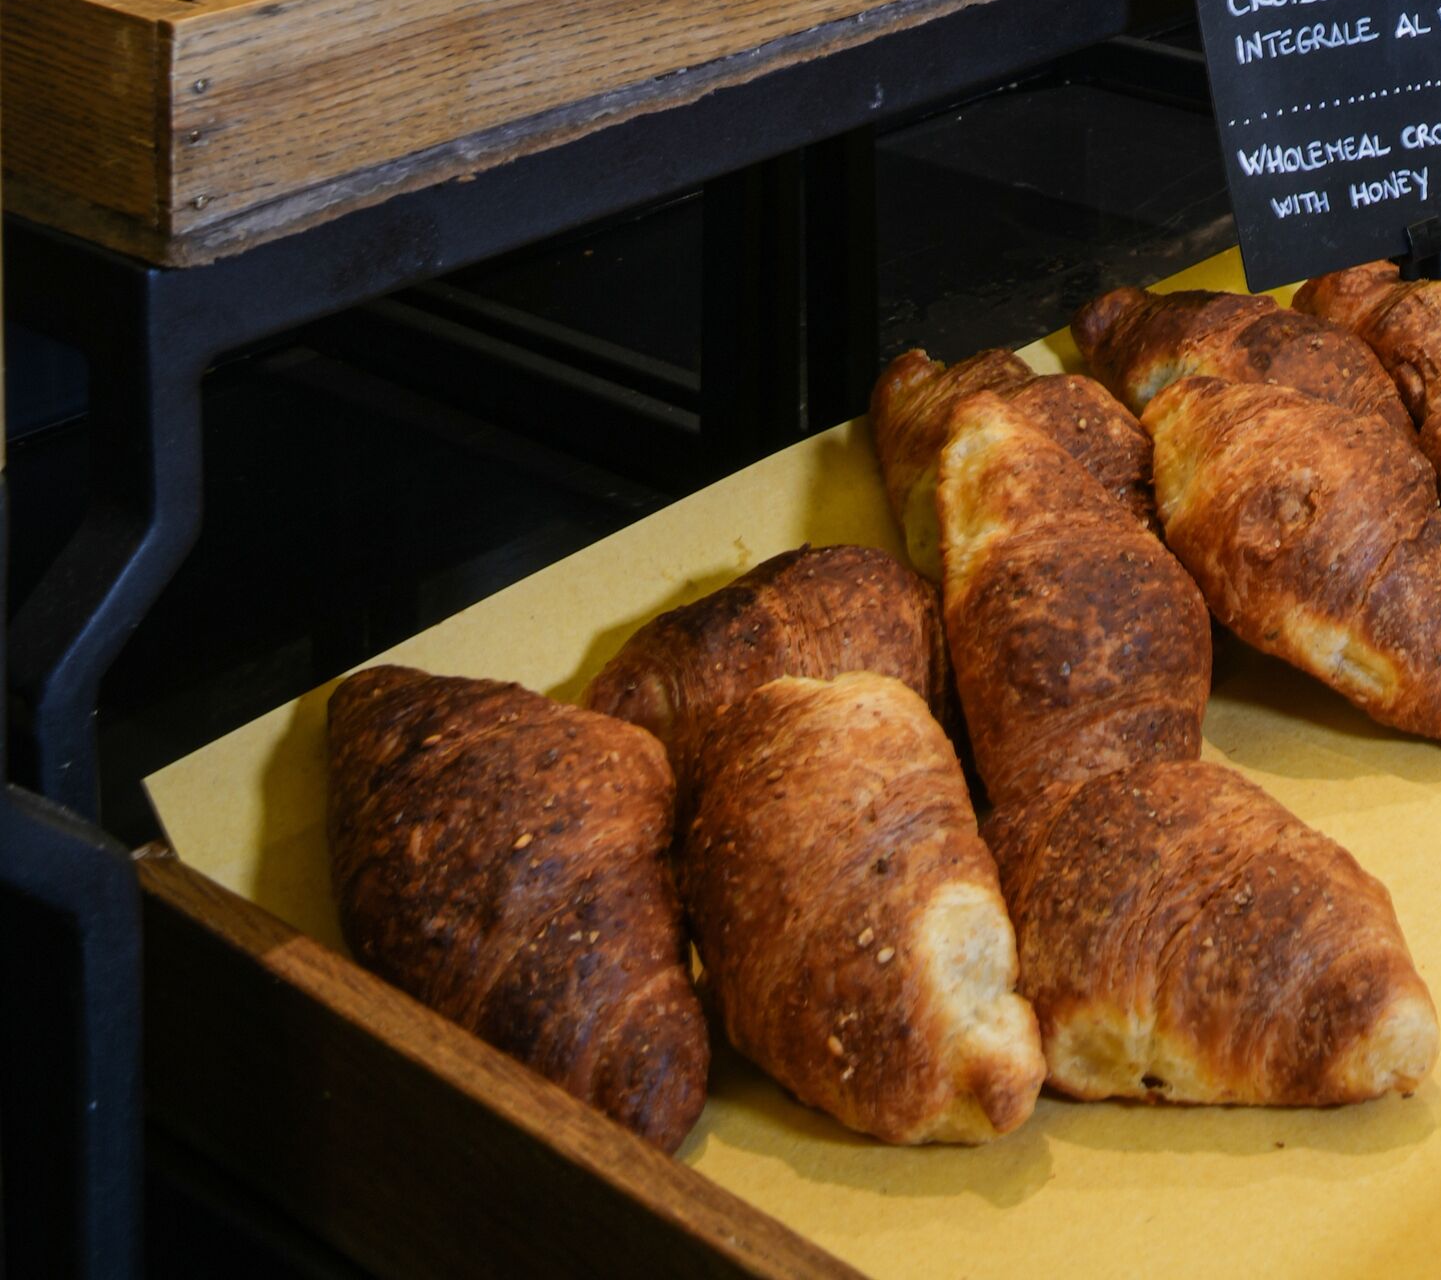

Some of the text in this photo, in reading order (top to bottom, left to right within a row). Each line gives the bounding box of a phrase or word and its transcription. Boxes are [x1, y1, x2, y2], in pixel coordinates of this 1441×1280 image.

[1234, 16, 1380, 66] INTEGRALE
[1394, 11, 1432, 40] AL
[1236, 133, 1392, 178] WHOLEMEAL
[1269, 166, 1429, 220] WITH HONEY
